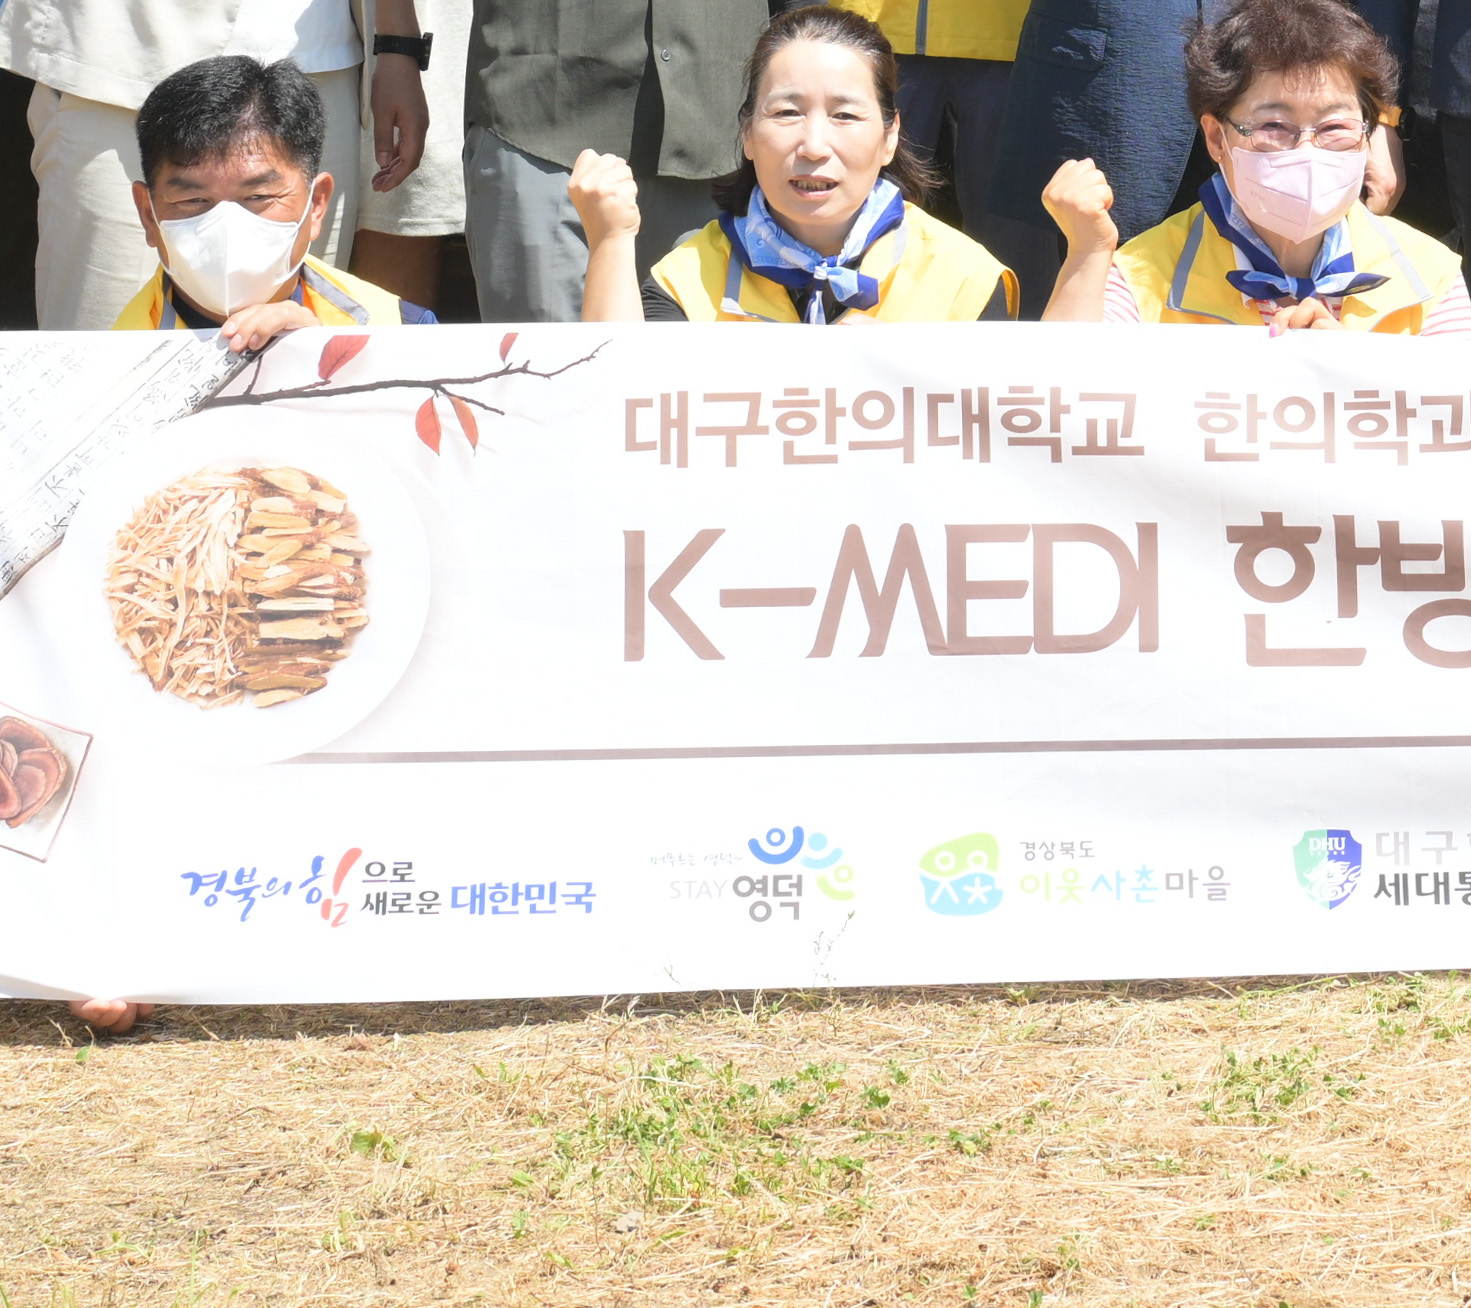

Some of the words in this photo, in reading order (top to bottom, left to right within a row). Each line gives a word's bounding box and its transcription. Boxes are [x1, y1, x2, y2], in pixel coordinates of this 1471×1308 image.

[624, 385, 1146, 468] 대구한의대학교
[1019, 840, 1096, 862] 경상북도
[1308, 835, 1346, 853] DHU
[180, 865, 292, 922] 경북의
[359, 888, 443, 917] 새로운
[450, 880, 597, 916] 대한민국
[669, 879, 728, 900] STAY
[732, 874, 804, 923] 영덕
[1019, 863, 1231, 905] 이웃사촌마을
